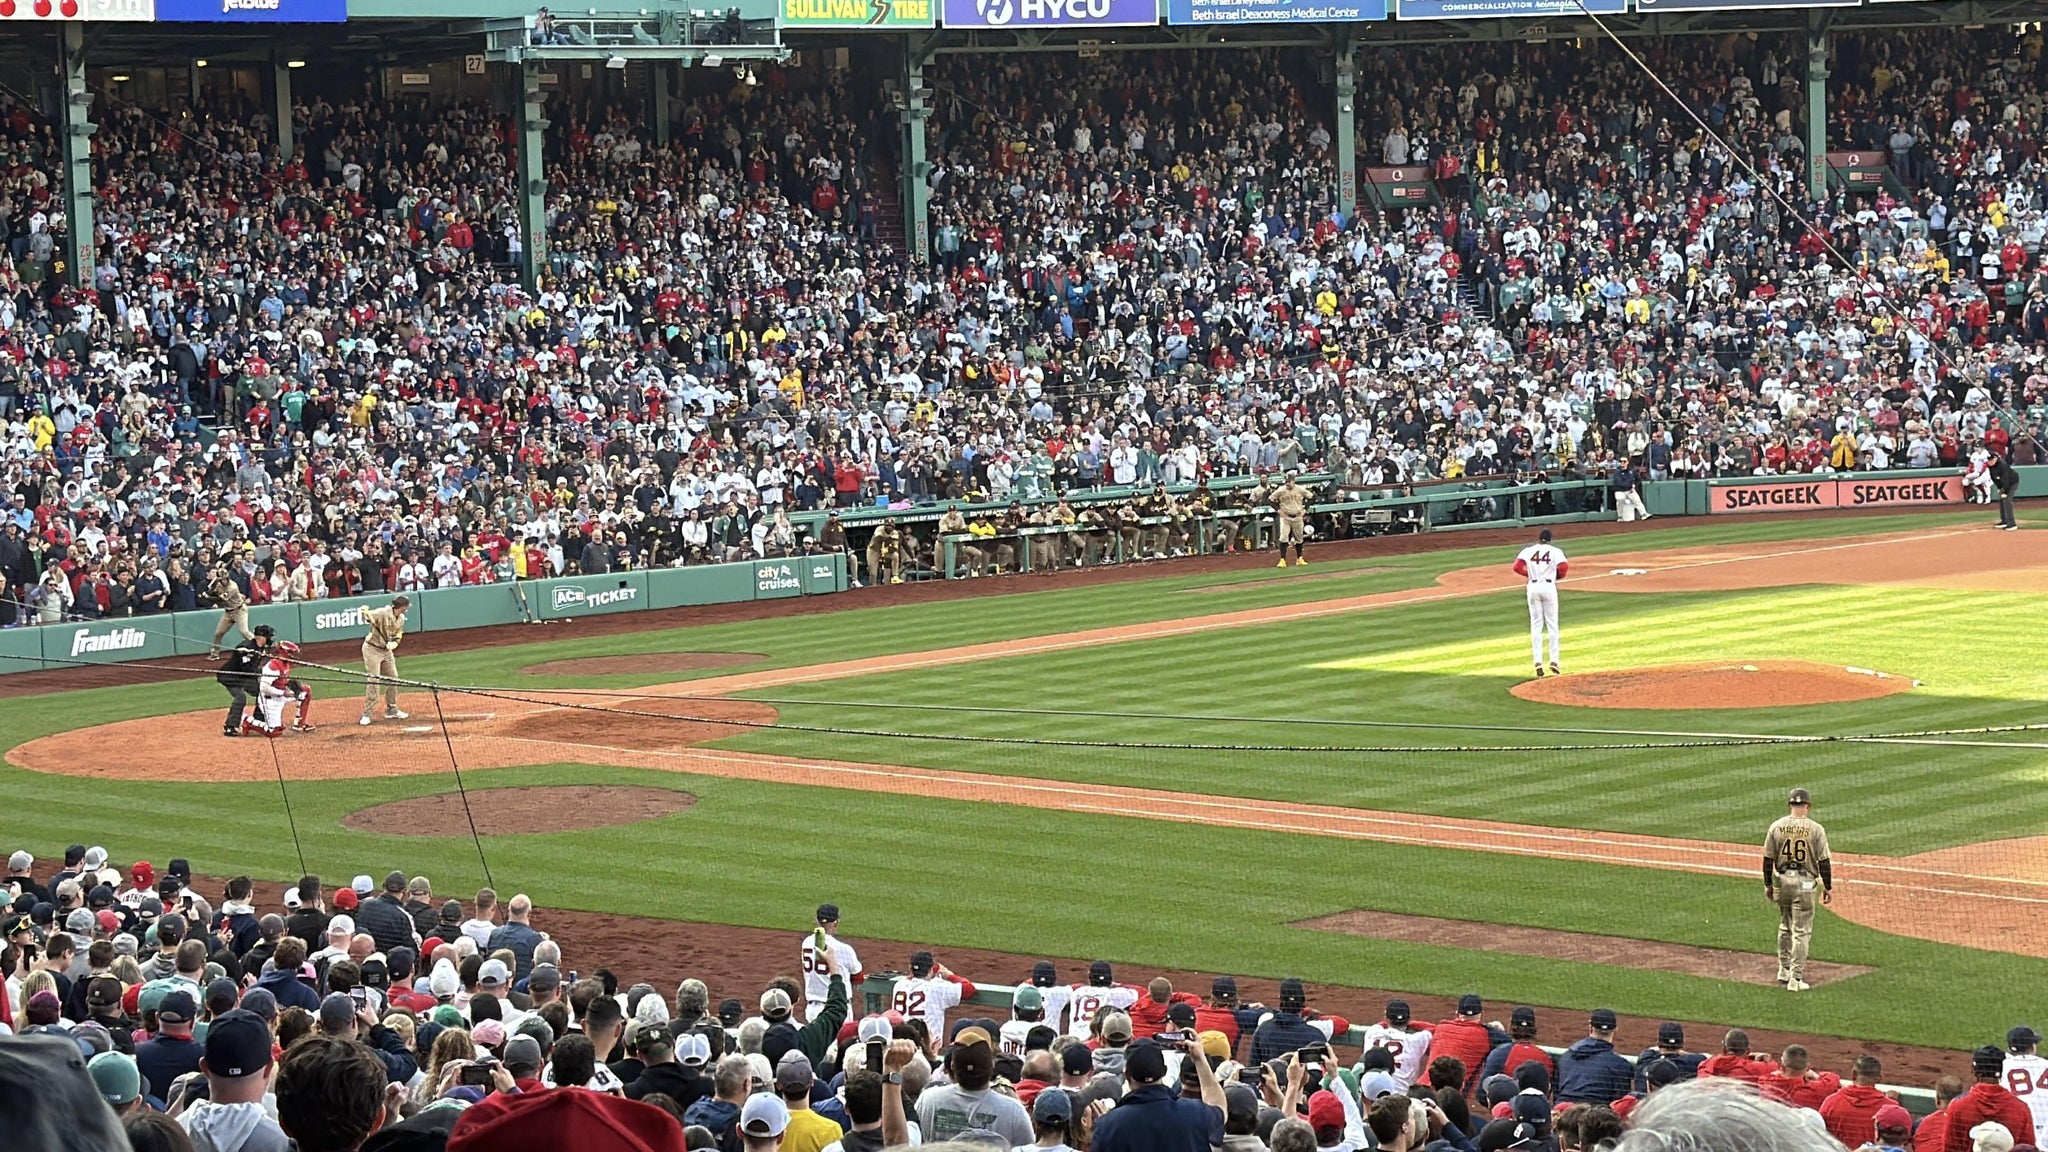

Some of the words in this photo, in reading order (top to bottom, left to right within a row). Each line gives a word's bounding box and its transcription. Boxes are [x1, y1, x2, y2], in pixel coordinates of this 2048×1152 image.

[786, 0, 867, 19] SULLIVAN
[892, 0, 929, 19] TIRE
[1020, 0, 1111, 19] HYCU
[1192, 10, 1214, 20] Beth
[1215, 9, 1239, 20] Israel
[1241, 9, 1290, 19] Deaconess
[1291, 7, 1327, 18] Medical
[1328, 7, 1359, 18] Center
[1442, 1, 1532, 11] COMMERCIALIZATION
[468, 57, 482, 71] 27
[1726, 484, 1822, 509] SEATGEEK
[1853, 480, 1949, 504] SEATGEEK
[1530, 550, 1552, 565] 44
[758, 566, 780, 580] city
[758, 578, 800, 590] cruises
[557, 589, 585, 602] ACE
[587, 588, 637, 608] TICKET
[70, 628, 146, 656] Franklin
[1779, 825, 1810, 838] MACIAS
[1781, 838, 1807, 862] 46
[894, 990, 926, 1016] 82
